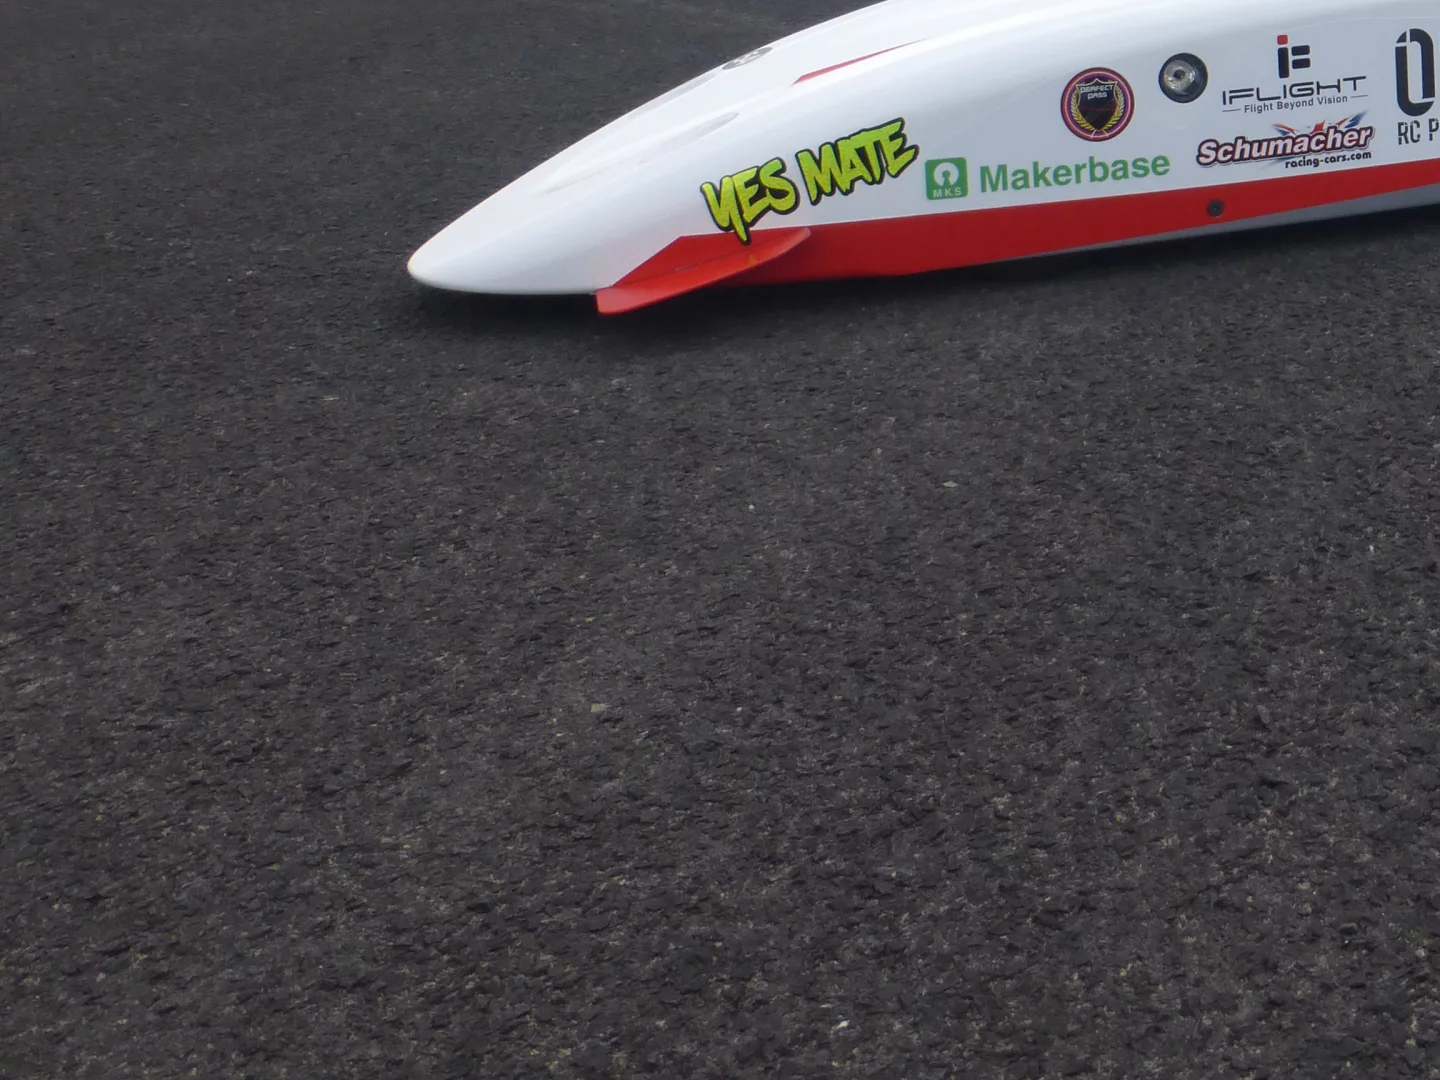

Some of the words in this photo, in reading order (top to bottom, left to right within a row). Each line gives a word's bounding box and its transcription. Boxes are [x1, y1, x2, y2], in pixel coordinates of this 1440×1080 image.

[1080, 84, 1114, 93] PERFECT
[1244, 103, 1273, 114] Flight
[1277, 98, 1314, 111] Beyond
[1317, 95, 1348, 105] Vision
[1398, 119, 1421, 145] RC
[1196, 126, 1374, 166] Schumacher
[1285, 151, 1372, 169] racing-cars.com
[700, 157, 800, 245] YES
[795, 117, 920, 206] MATE
[980, 155, 1171, 193] Makerbase
[933, 187, 962, 199] MKS
